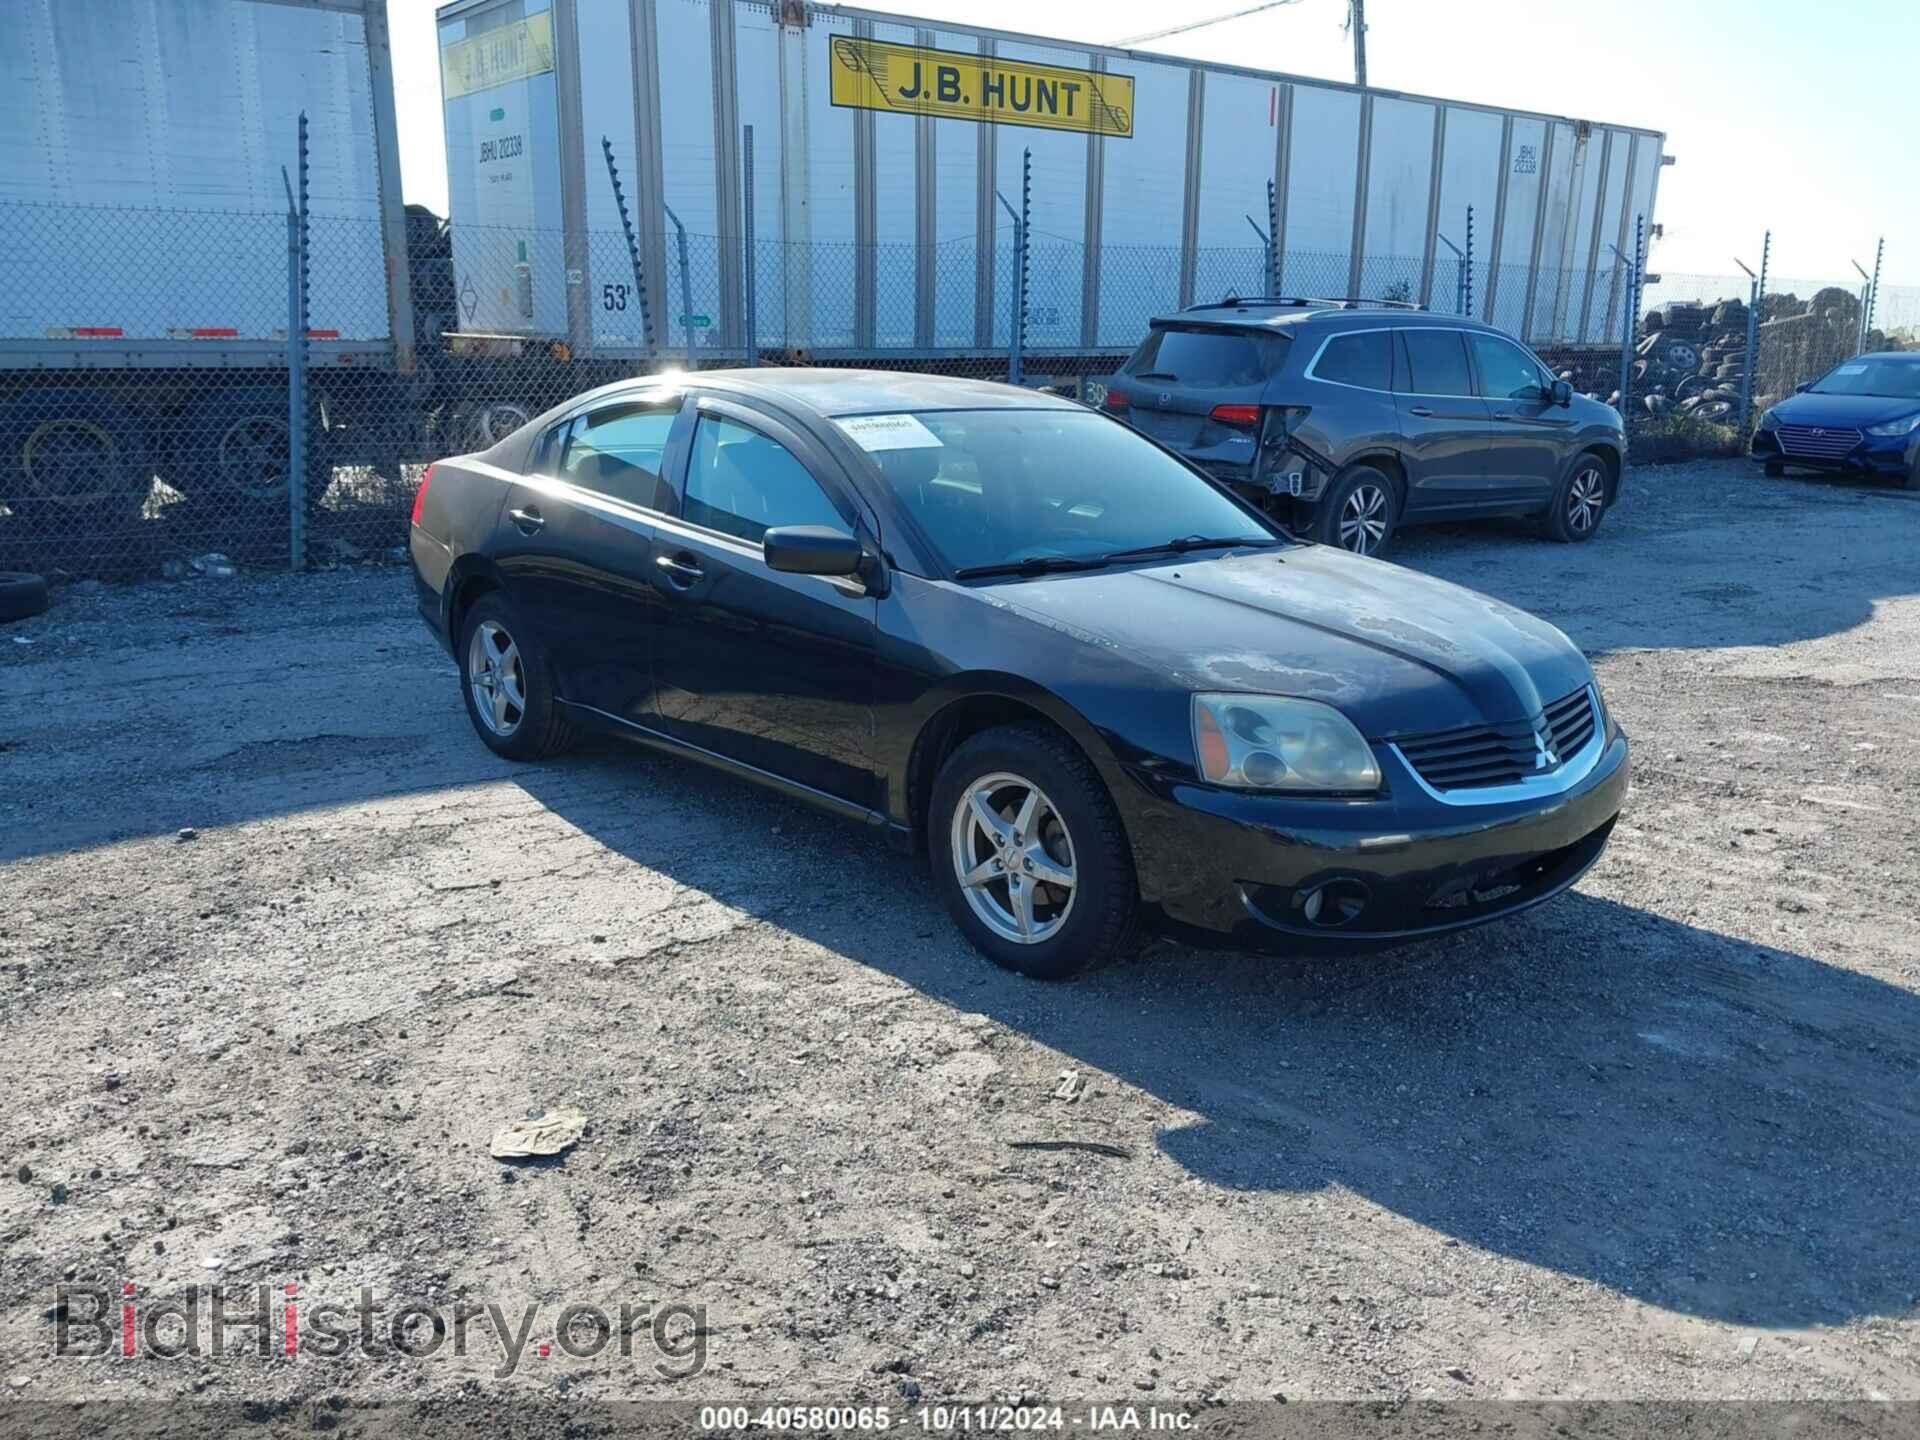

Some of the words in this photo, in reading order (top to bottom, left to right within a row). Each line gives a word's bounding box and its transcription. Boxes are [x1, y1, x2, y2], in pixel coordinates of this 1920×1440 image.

[898, 62, 970, 105] J.B.
[982, 71, 1081, 117] HUNT
[604, 284, 631, 311] 53'
